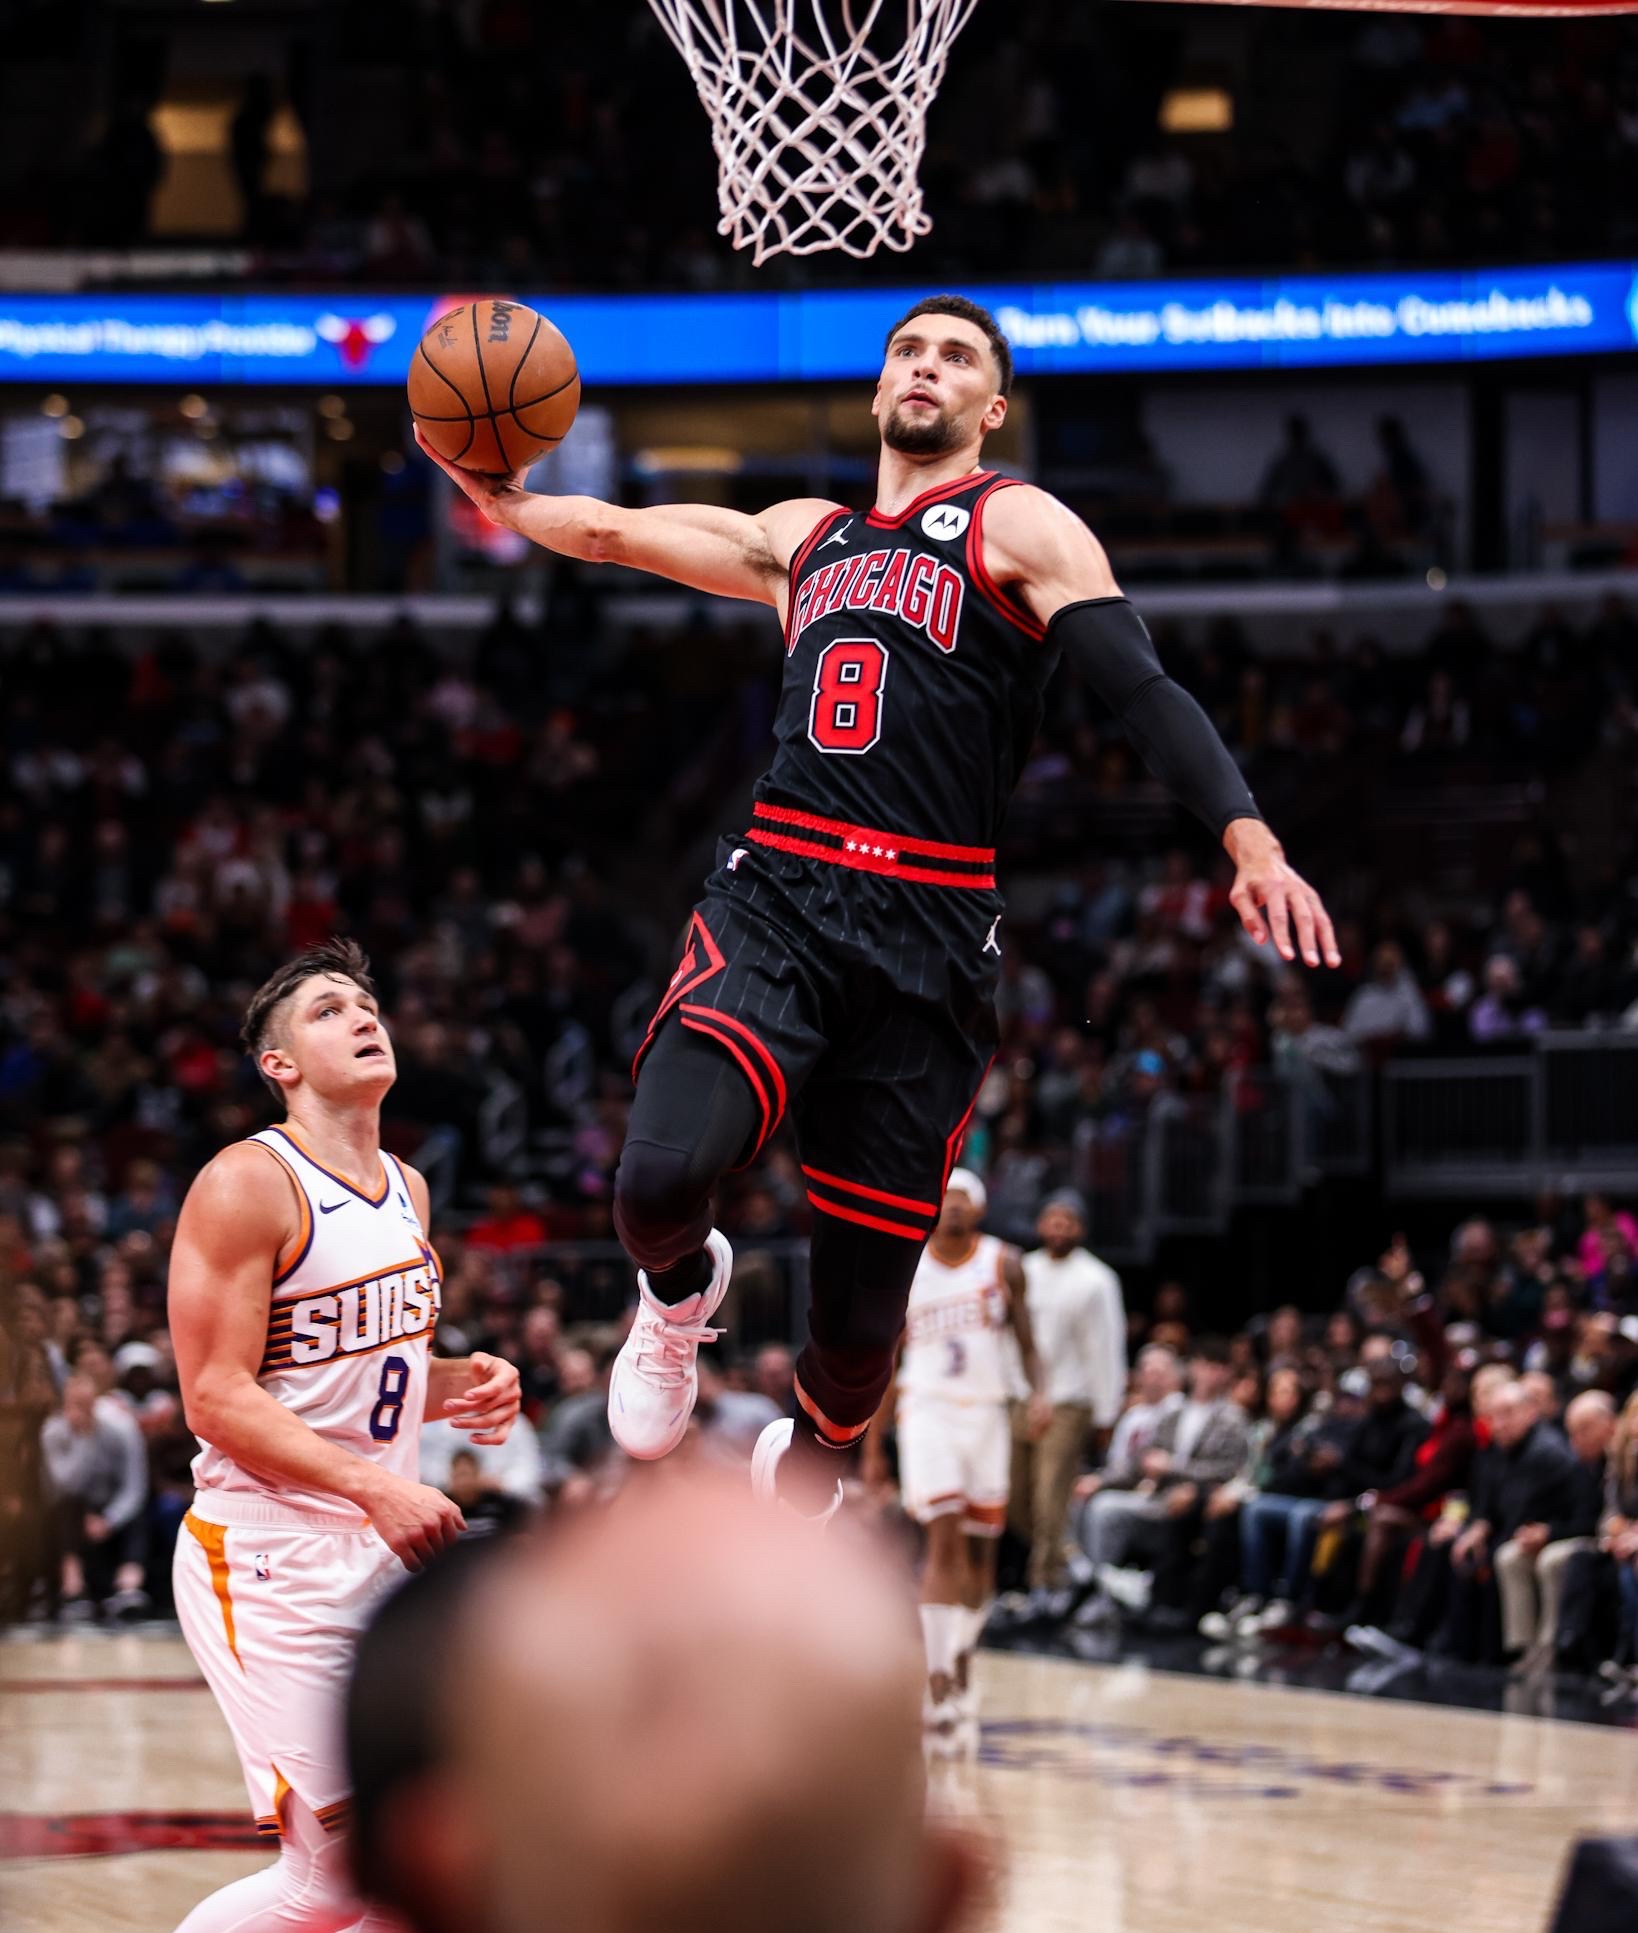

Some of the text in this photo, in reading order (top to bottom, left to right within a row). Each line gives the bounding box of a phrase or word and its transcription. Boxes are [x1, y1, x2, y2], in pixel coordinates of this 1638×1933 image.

[1398, 286, 1594, 336] Comebacks
[787, 548, 965, 658] CHICAGO
[807, 638, 889, 754] 8
[290, 1265, 433, 1364] SUNS
[369, 1355, 410, 1444] 8
